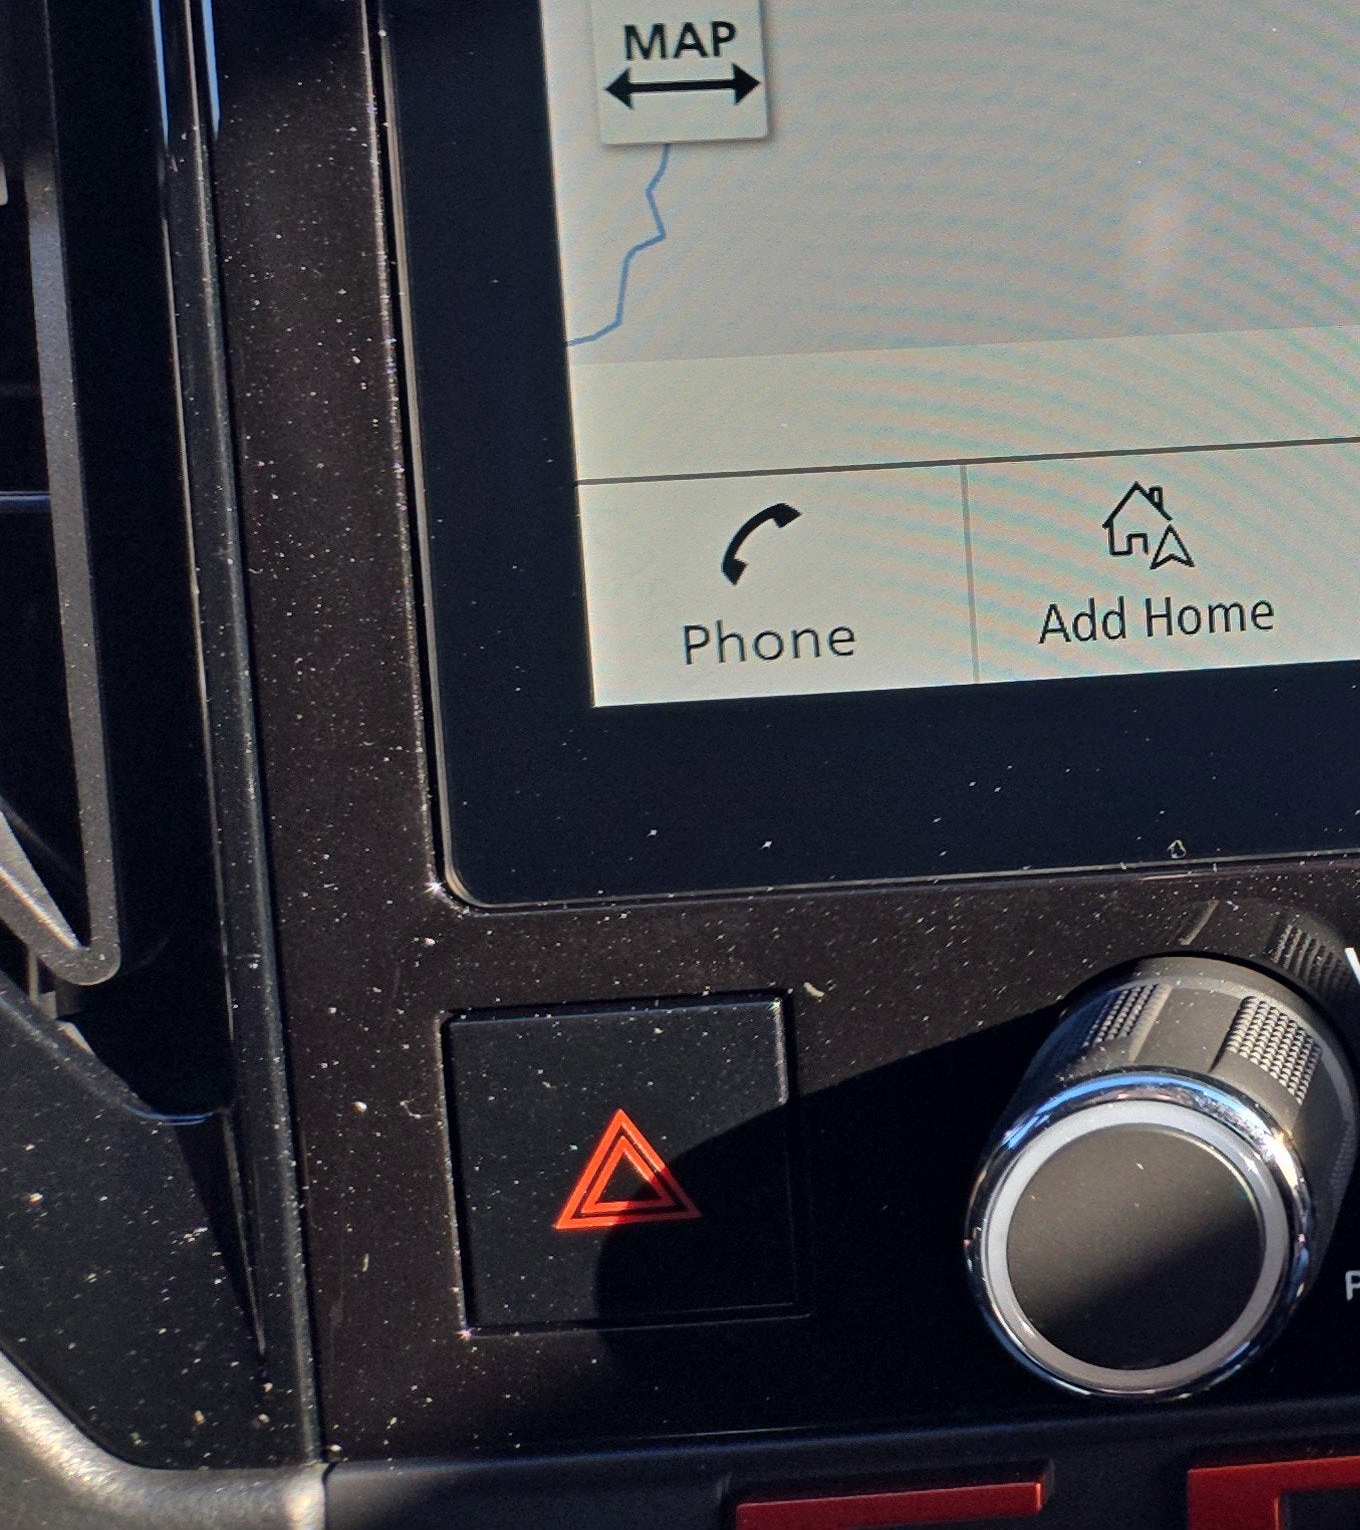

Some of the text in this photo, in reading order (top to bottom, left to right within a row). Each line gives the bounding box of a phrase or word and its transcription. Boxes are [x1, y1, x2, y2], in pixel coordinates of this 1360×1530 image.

[624, 21, 736, 60] MAP
[1038, 595, 1275, 644] Add Home
[683, 620, 856, 664] Phone
